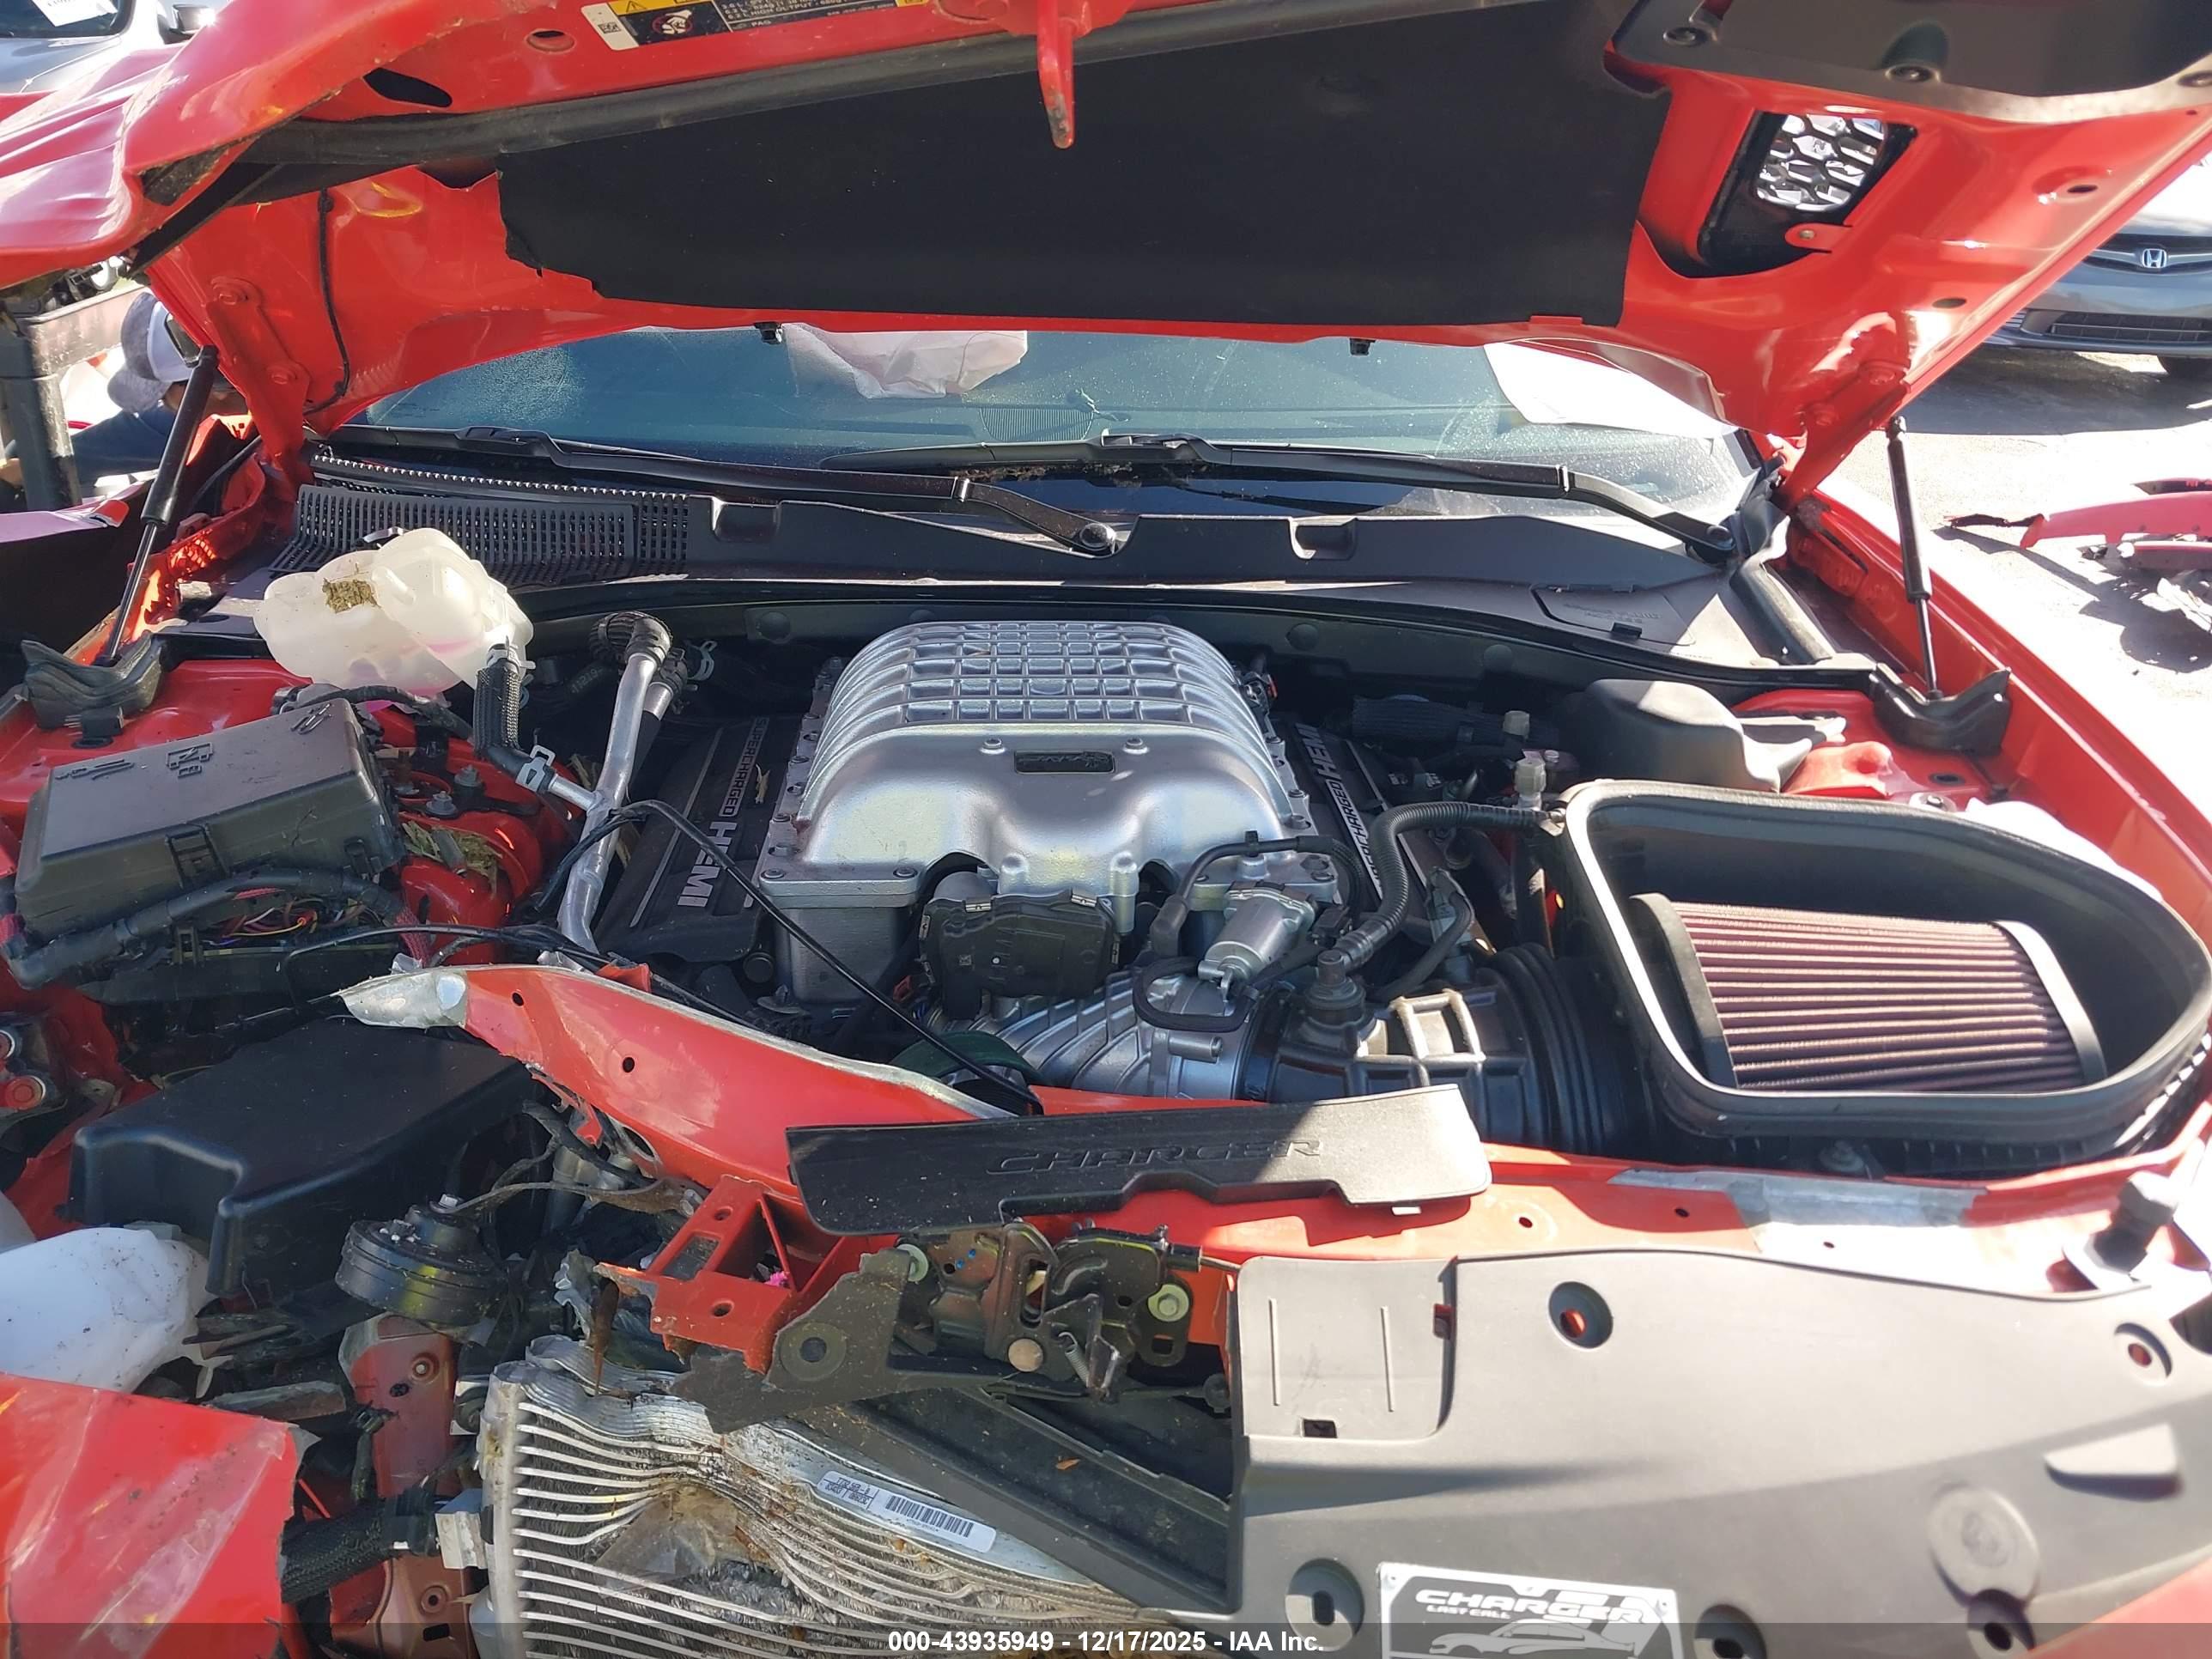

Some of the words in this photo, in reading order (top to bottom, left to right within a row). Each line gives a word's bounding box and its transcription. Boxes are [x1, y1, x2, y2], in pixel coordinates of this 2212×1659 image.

[720, 716, 769, 816] SUPERCHARGED
[1295, 722, 1342, 781] HEMI
[986, 1139, 1321, 1175] CHARGER
[1415, 1589, 1644, 1624] CHARGER
[1425, 1604, 1468, 1615] LAST
